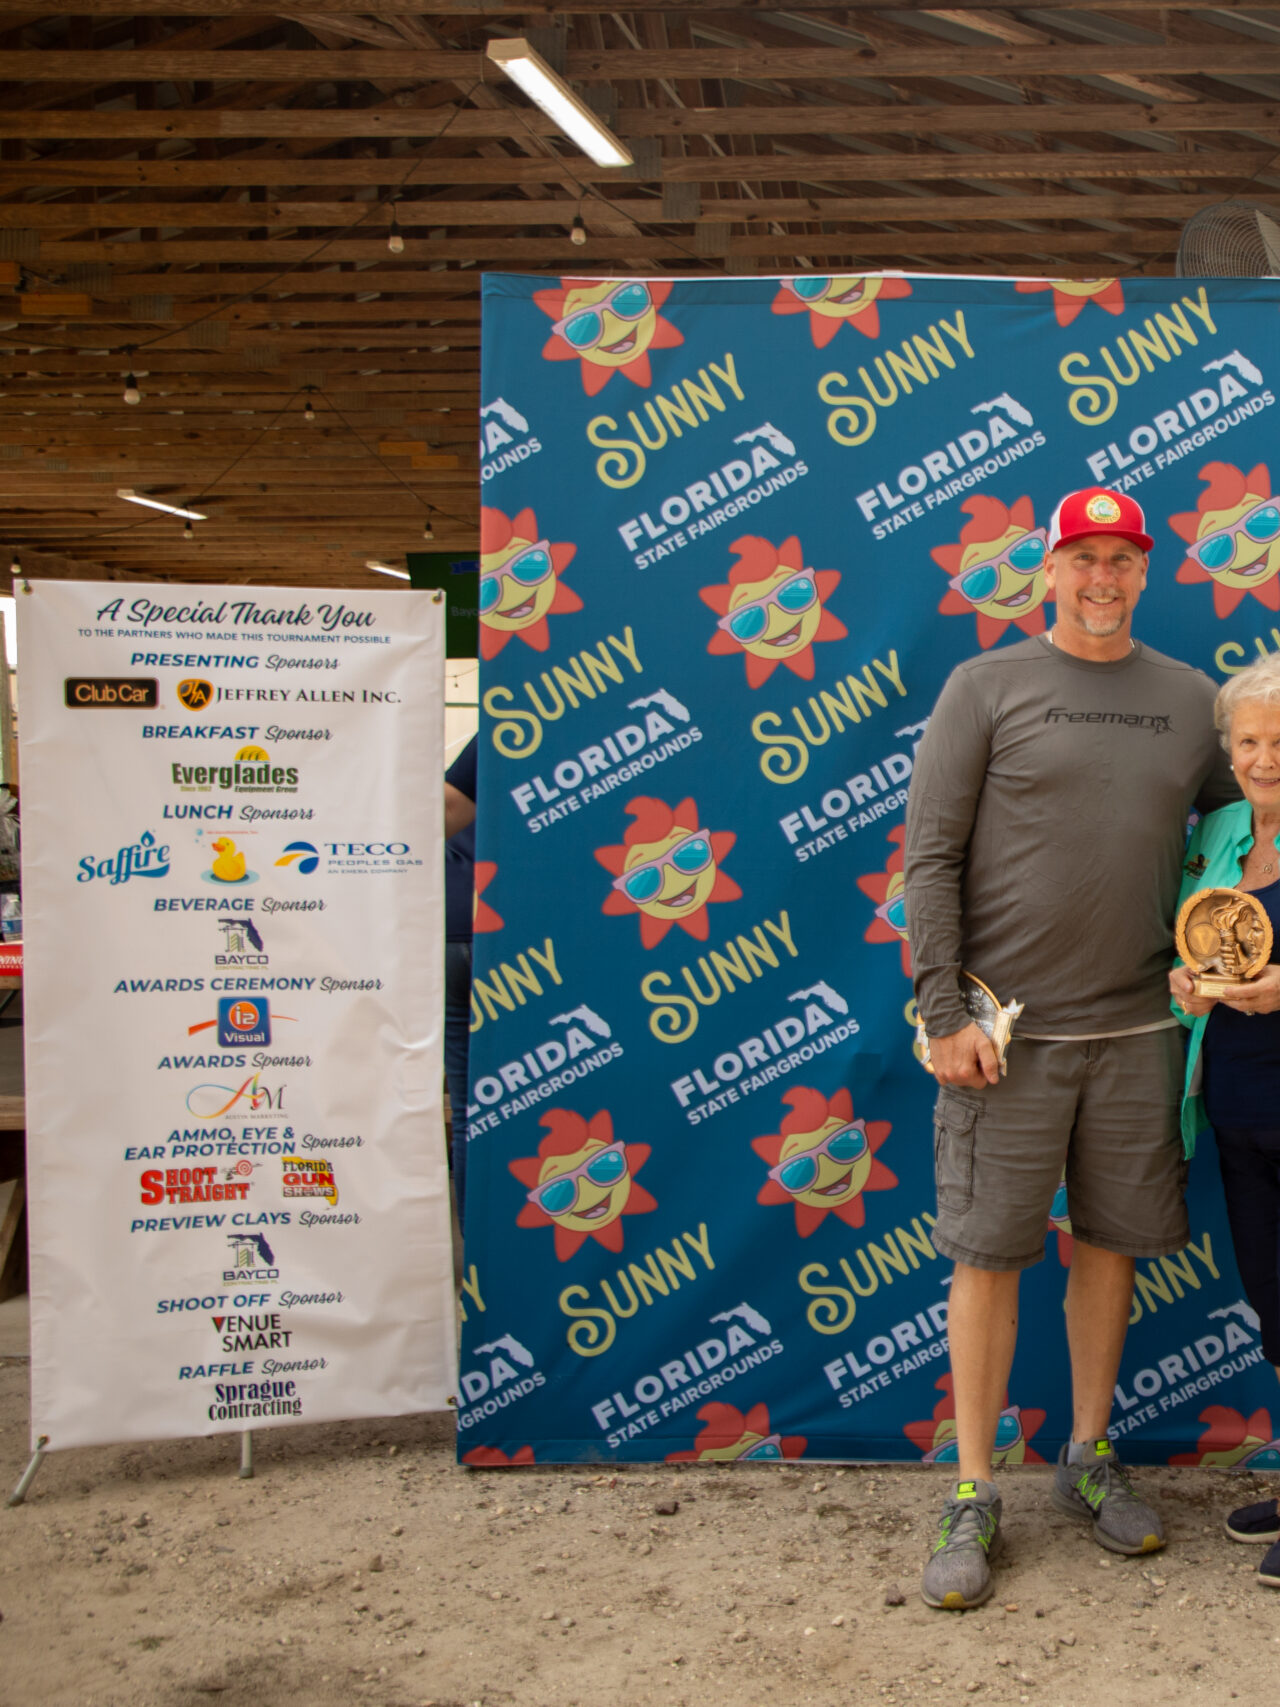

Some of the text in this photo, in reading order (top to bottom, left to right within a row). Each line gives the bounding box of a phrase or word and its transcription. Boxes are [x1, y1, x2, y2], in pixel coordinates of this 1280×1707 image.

[818, 310, 975, 447] SUNNY
[587, 353, 745, 489] SUNNY
[855, 415, 1018, 522] FLORIDA
[873, 502, 925, 540] STATE
[924, 430, 1046, 510] FAIRGROUNDS
[618, 445, 781, 552] FLORIDA
[635, 460, 809, 570] STATE FAIRGROUNDS
[97, 599, 376, 631] A Special Thank You
[78, 629, 92, 637] TO
[94, 629, 114, 637] THE
[117, 629, 172, 638] PARTNERS
[206, 632, 237, 640] MADE
[241, 632, 264, 641] THIS
[267, 634, 340, 642] TOURNAMENT
[343, 635, 390, 643] POSSIBLE
[131, 653, 338, 672] PRESENTING Sponsors
[217, 687, 400, 703] JEFFREY ALLEN INC.
[484, 625, 642, 758] SUNNY
[143, 725, 330, 743] BREAKFAST Sponsor
[512, 712, 675, 815] FLORIDA
[172, 763, 298, 789] Everglades
[528, 726, 703, 833] STATE FAIRGROUNDS
[163, 805, 313, 823] LUNCH Sponsors
[324, 843, 411, 856] TECO
[77, 845, 169, 885] Saffire
[154, 897, 324, 915] BEVERAGE Sponsor
[215, 955, 269, 965] BAYCO
[114, 976, 382, 994] AWARDS CEREMONY Sponsor
[641, 909, 799, 1045] SUNNY
[225, 1032, 265, 1042] Visual
[158, 1052, 312, 1070] AWARDS Sponsor
[671, 1001, 834, 1108] FLORIDA
[688, 1018, 862, 1125] STATE FAIRGROUNDS
[167, 1127, 294, 1142] AMMO, EYE &
[125, 1134, 363, 1160] EAR PROTECTION Sponsor
[283, 1161, 333, 1173] FLORIDA
[283, 1174, 334, 1186] GUN
[131, 1211, 361, 1233] PREVIEW CLAYS Sponsor
[223, 1269, 279, 1281] BAYCO
[157, 1291, 343, 1313] SHOOT OFF Sponsor
[223, 1331, 292, 1352] SMART
[179, 1358, 325, 1379] RAFFLE Sponsor
[215, 1380, 295, 1404] Sprague
[208, 1398, 302, 1421] Contracting
